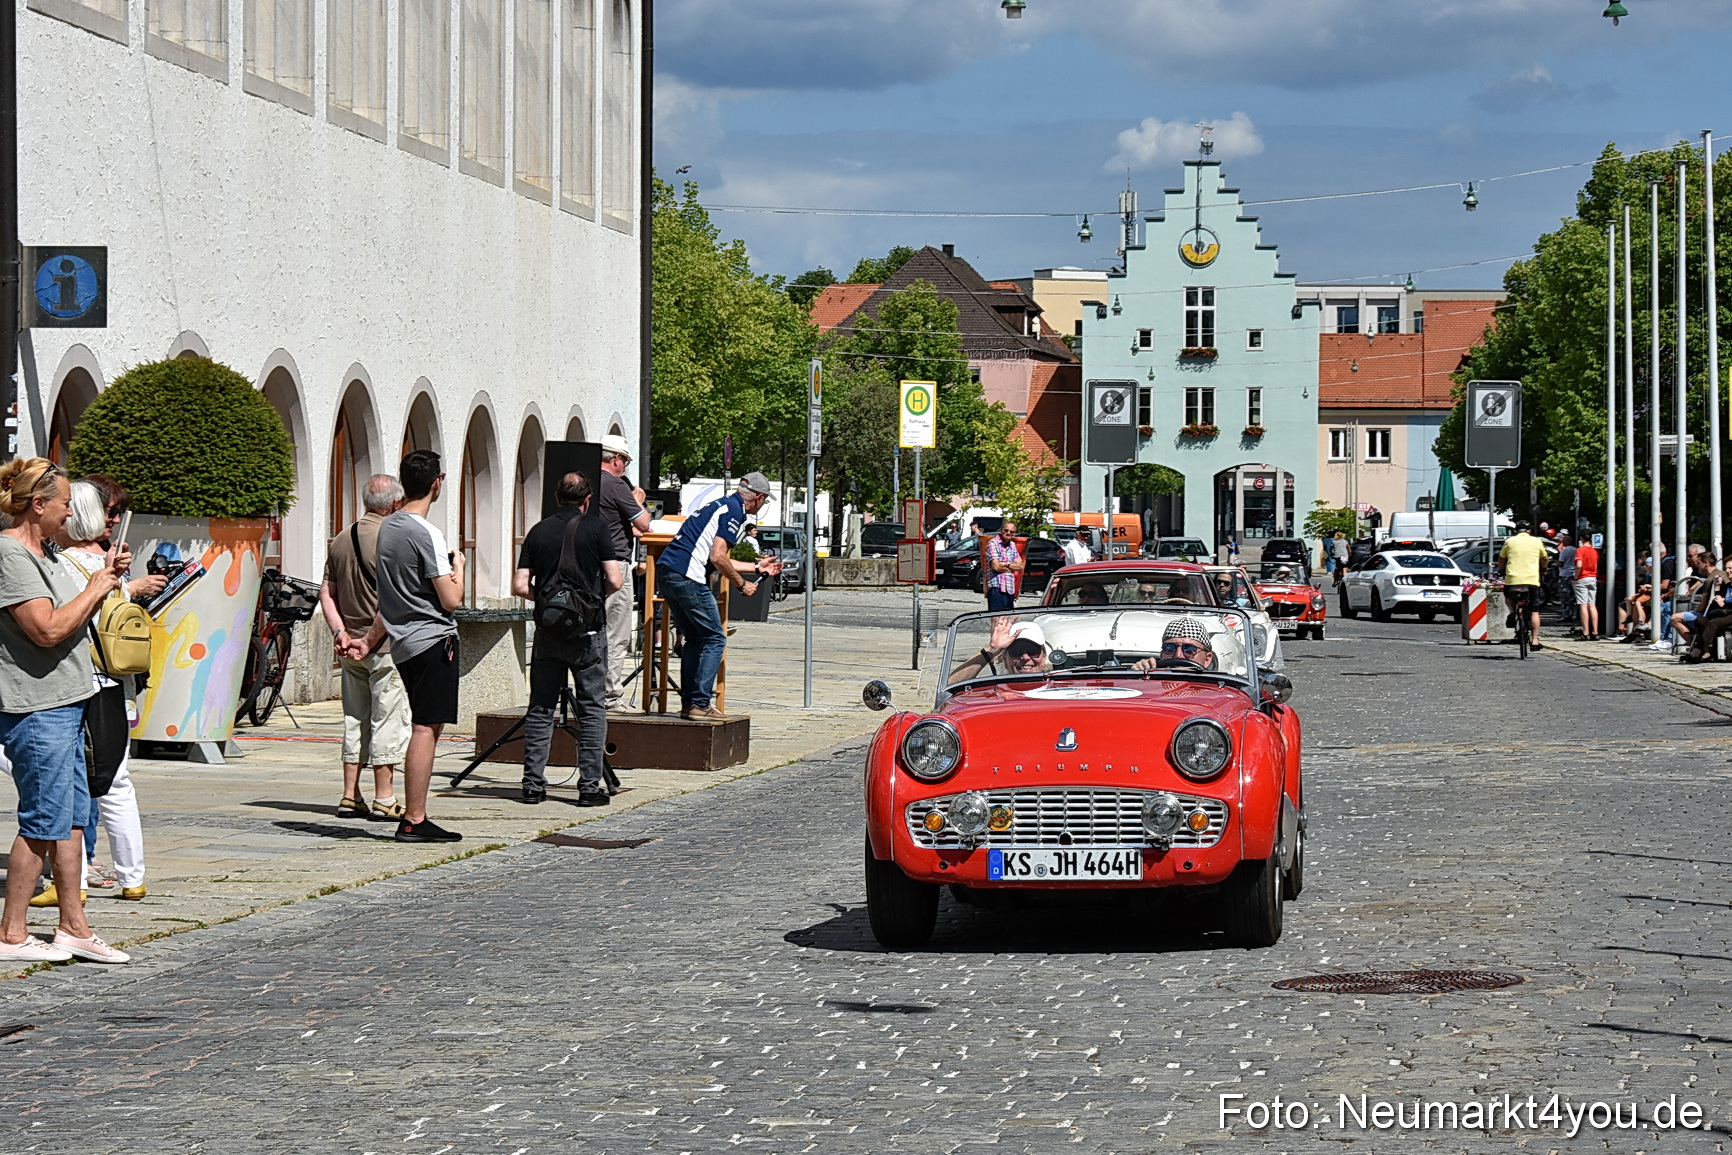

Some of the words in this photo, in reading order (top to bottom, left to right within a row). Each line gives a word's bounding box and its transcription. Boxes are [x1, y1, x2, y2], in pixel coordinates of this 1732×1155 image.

[912, 392, 924, 410] H
[1102, 415, 1122, 423] ZONE
[993, 763, 1139, 775] TRIUMPH
[1003, 851, 1032, 877] KS
[1049, 851, 1078, 877] JH
[1083, 851, 1140, 877] 464H
